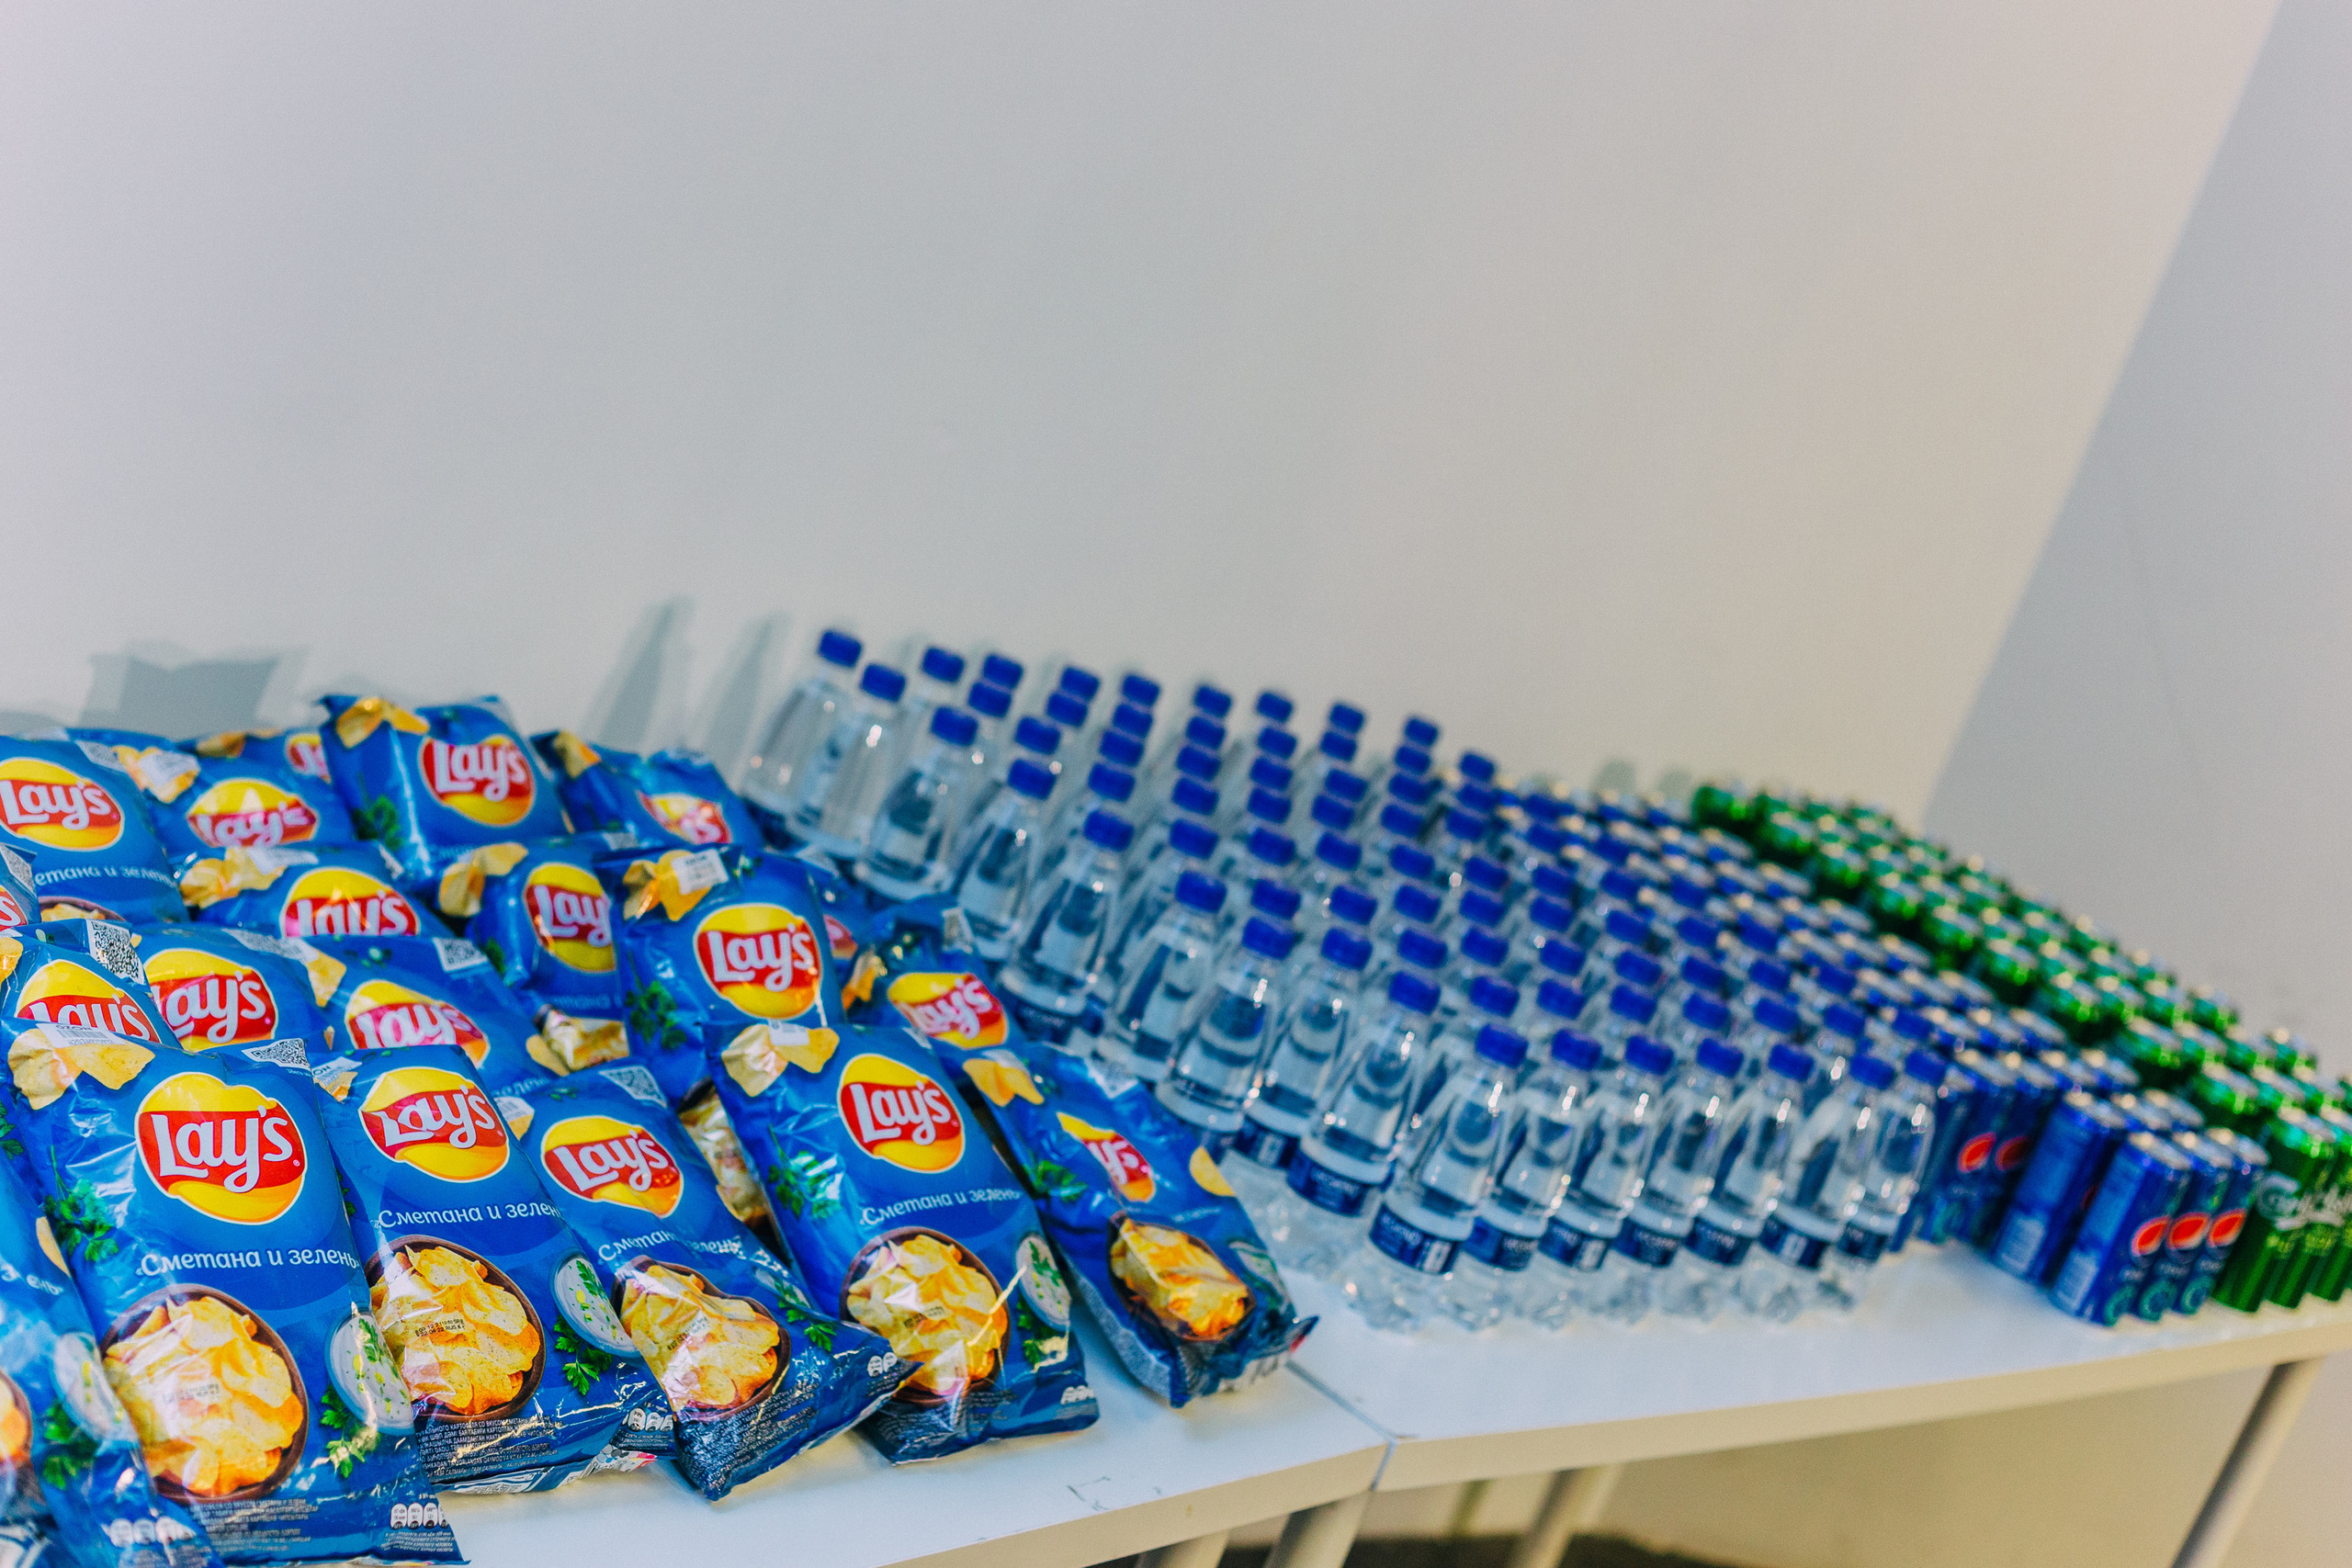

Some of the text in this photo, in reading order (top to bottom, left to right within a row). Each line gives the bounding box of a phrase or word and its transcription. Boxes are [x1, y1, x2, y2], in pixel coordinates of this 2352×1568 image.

[0, 780, 111, 830] Lay's
[707, 922, 814, 992] Lay's
[371, 1085, 495, 1149] Lay's
[850, 1080, 951, 1146] Lay's
[151, 1105, 293, 1193] Lay's
[553, 1129, 669, 1192] Lay's
[487, 1205, 502, 1220] и
[955, 1193, 968, 1205] и
[267, 1250, 284, 1266] и
